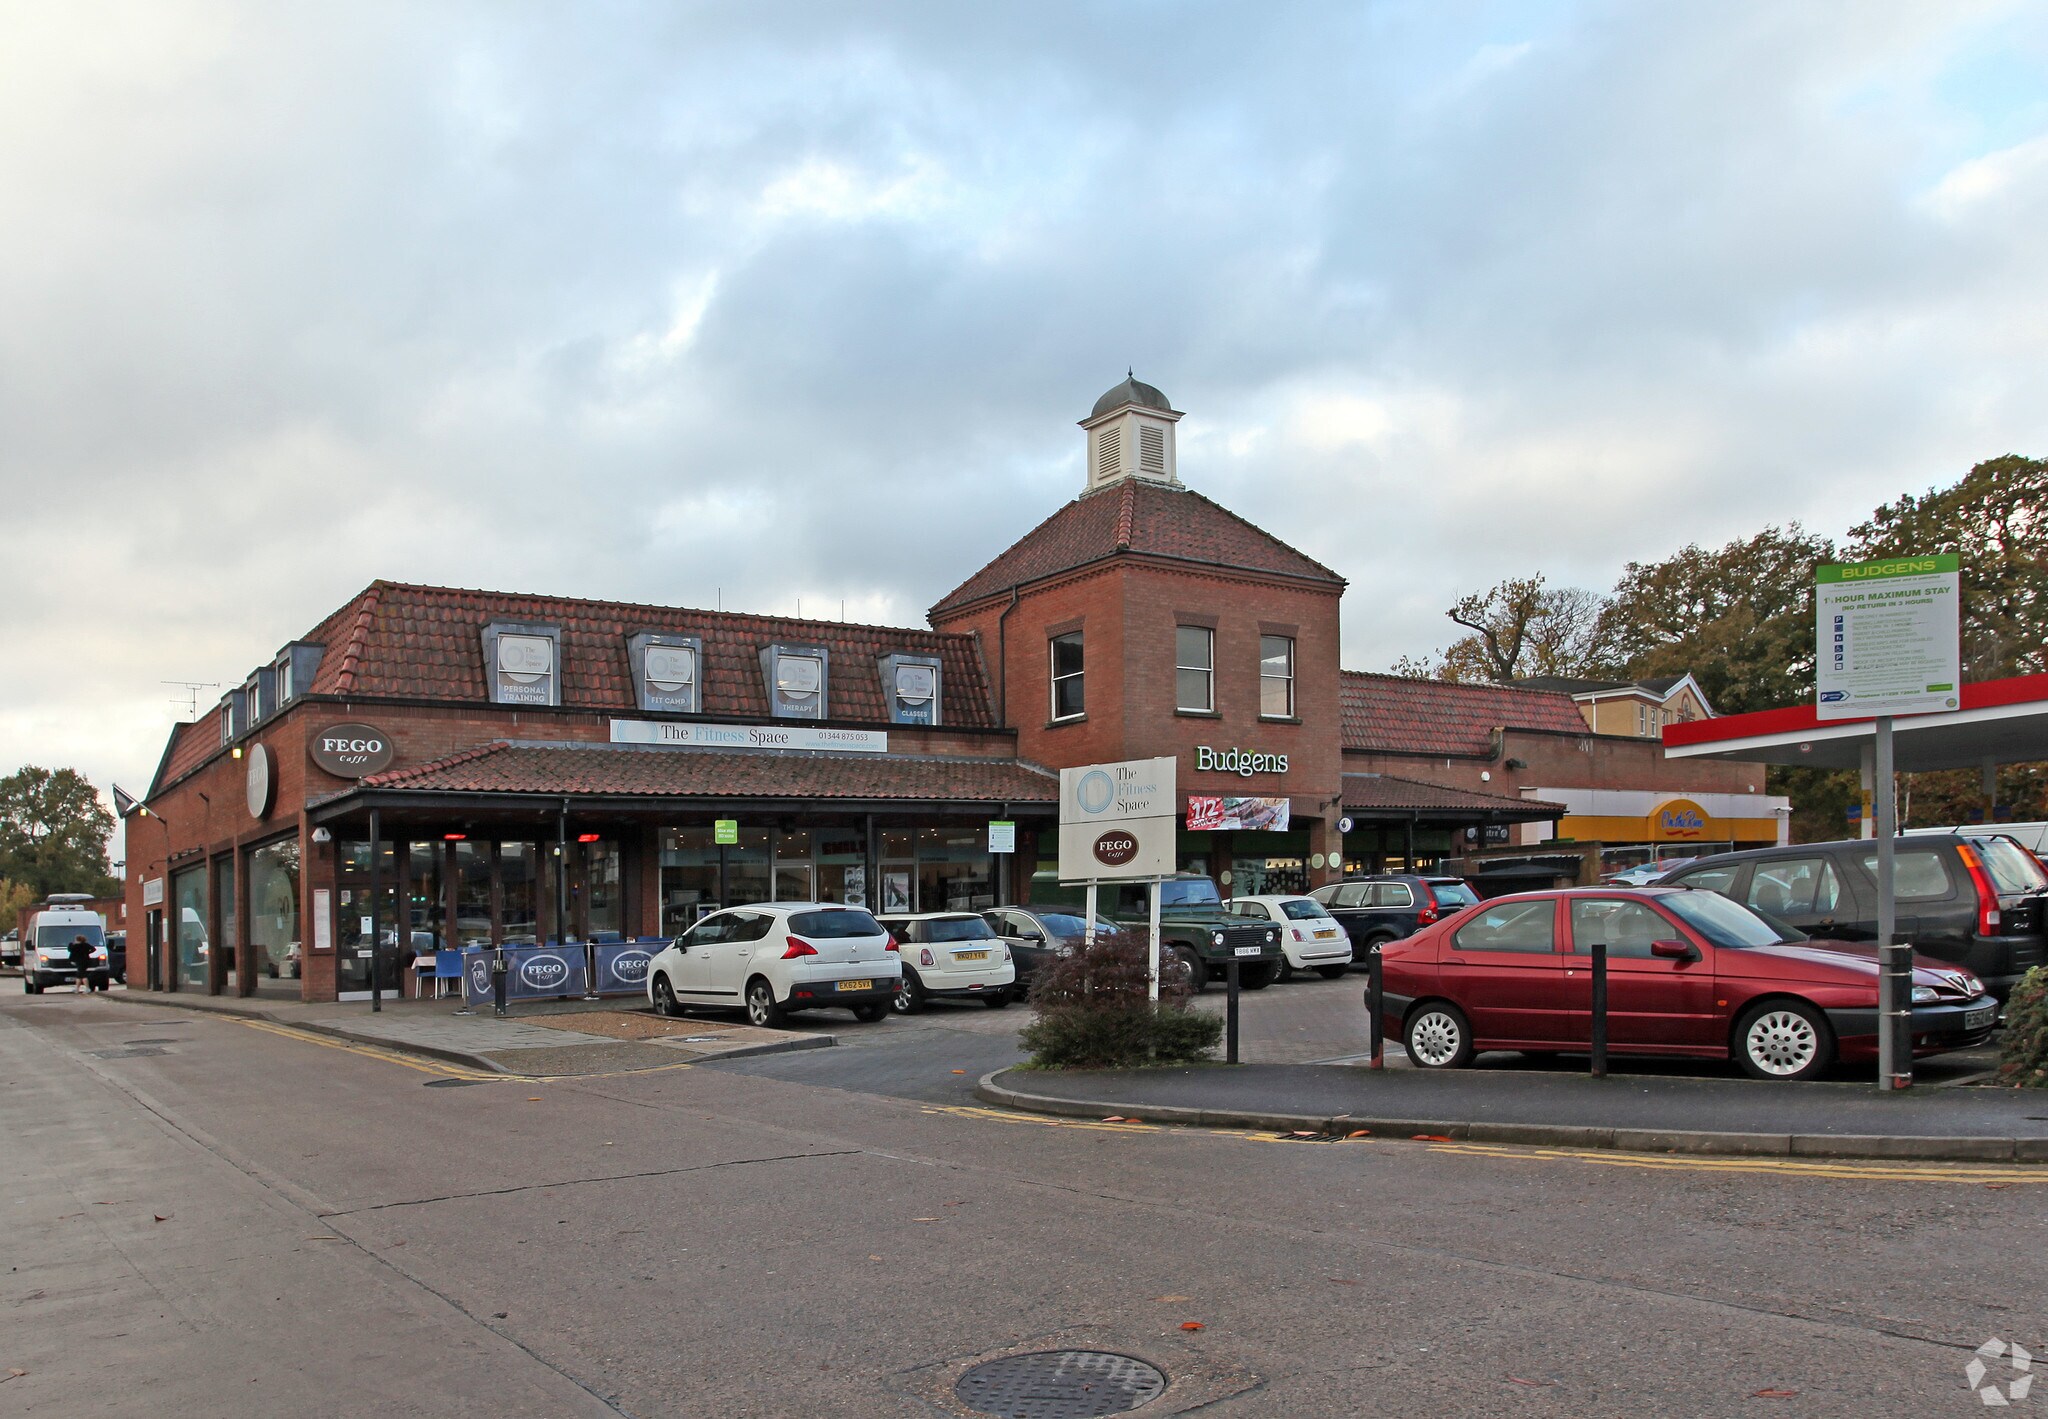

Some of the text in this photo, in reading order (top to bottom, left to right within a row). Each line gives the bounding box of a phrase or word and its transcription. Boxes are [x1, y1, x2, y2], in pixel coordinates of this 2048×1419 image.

[1841, 560, 1936, 579] BUDGENS
[1835, 594, 1865, 604] HOUR
[1868, 589, 1921, 601] MAXIMUM
[1925, 586, 1951, 596] STAY
[1857, 602, 1887, 610] RETURN
[503, 685, 546, 694] PERSONAL
[504, 692, 545, 702] TRAINING
[651, 696, 686, 705] FIT CAMP
[782, 704, 813, 712] THERAPY
[901, 710, 928, 718] CLASSES
[661, 725, 789, 746] The Fitness Space
[818, 731, 868, 741] 01344 875 053
[322, 738, 383, 753] FEGO
[1196, 745, 1289, 777] Budgens
[1116, 767, 1137, 781] The
[1117, 783, 1157, 796] Fitness
[1117, 799, 1150, 814] Space
[1192, 799, 1219, 819] 1/2
[1685, 810, 1705, 829] Run
[1099, 839, 1132, 851] FEGO
[528, 964, 561, 974] FEGO
[618, 959, 649, 969] FEGO
[839, 980, 871, 990] EK62 SVX
